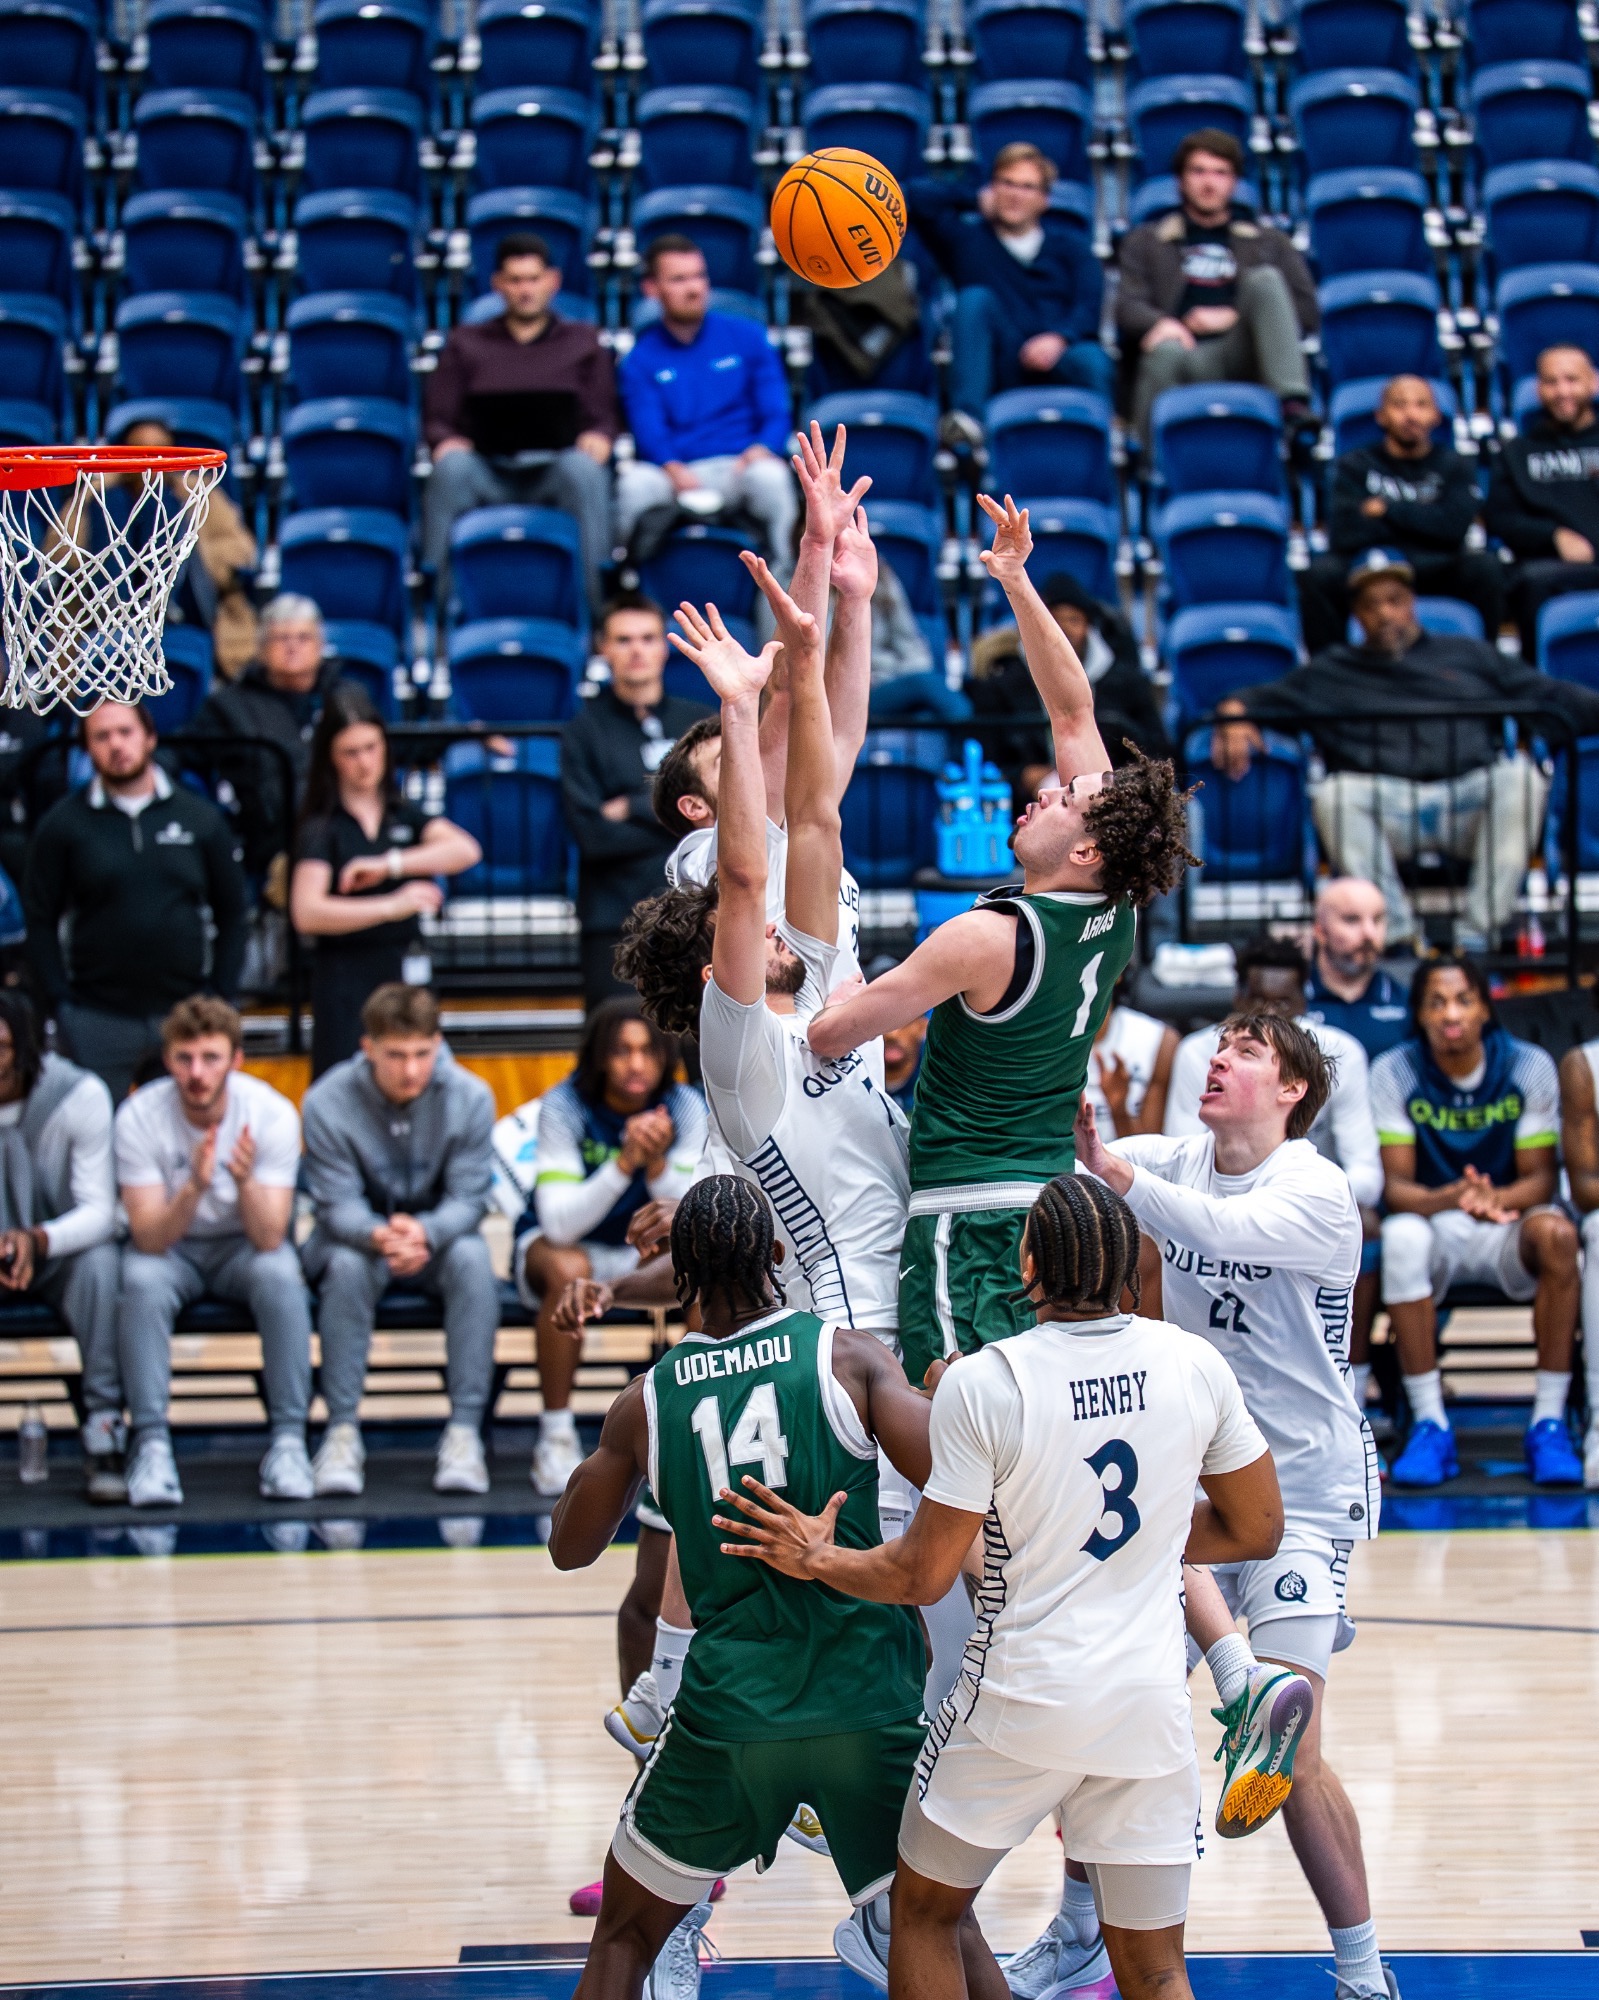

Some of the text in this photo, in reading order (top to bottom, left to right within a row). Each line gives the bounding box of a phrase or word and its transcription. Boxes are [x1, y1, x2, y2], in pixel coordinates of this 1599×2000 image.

[864, 172, 905, 238] Wilso
[1078, 905, 1117, 943] ARIAS
[1070, 951, 1105, 1039] 1
[1410, 1093, 1520, 1131] QUEENS
[675, 1335, 791, 1386] UDEMADU
[1069, 1371, 1147, 1421] HENRY
[691, 1382, 789, 1502] 14
[1079, 1438, 1141, 1562] 3
